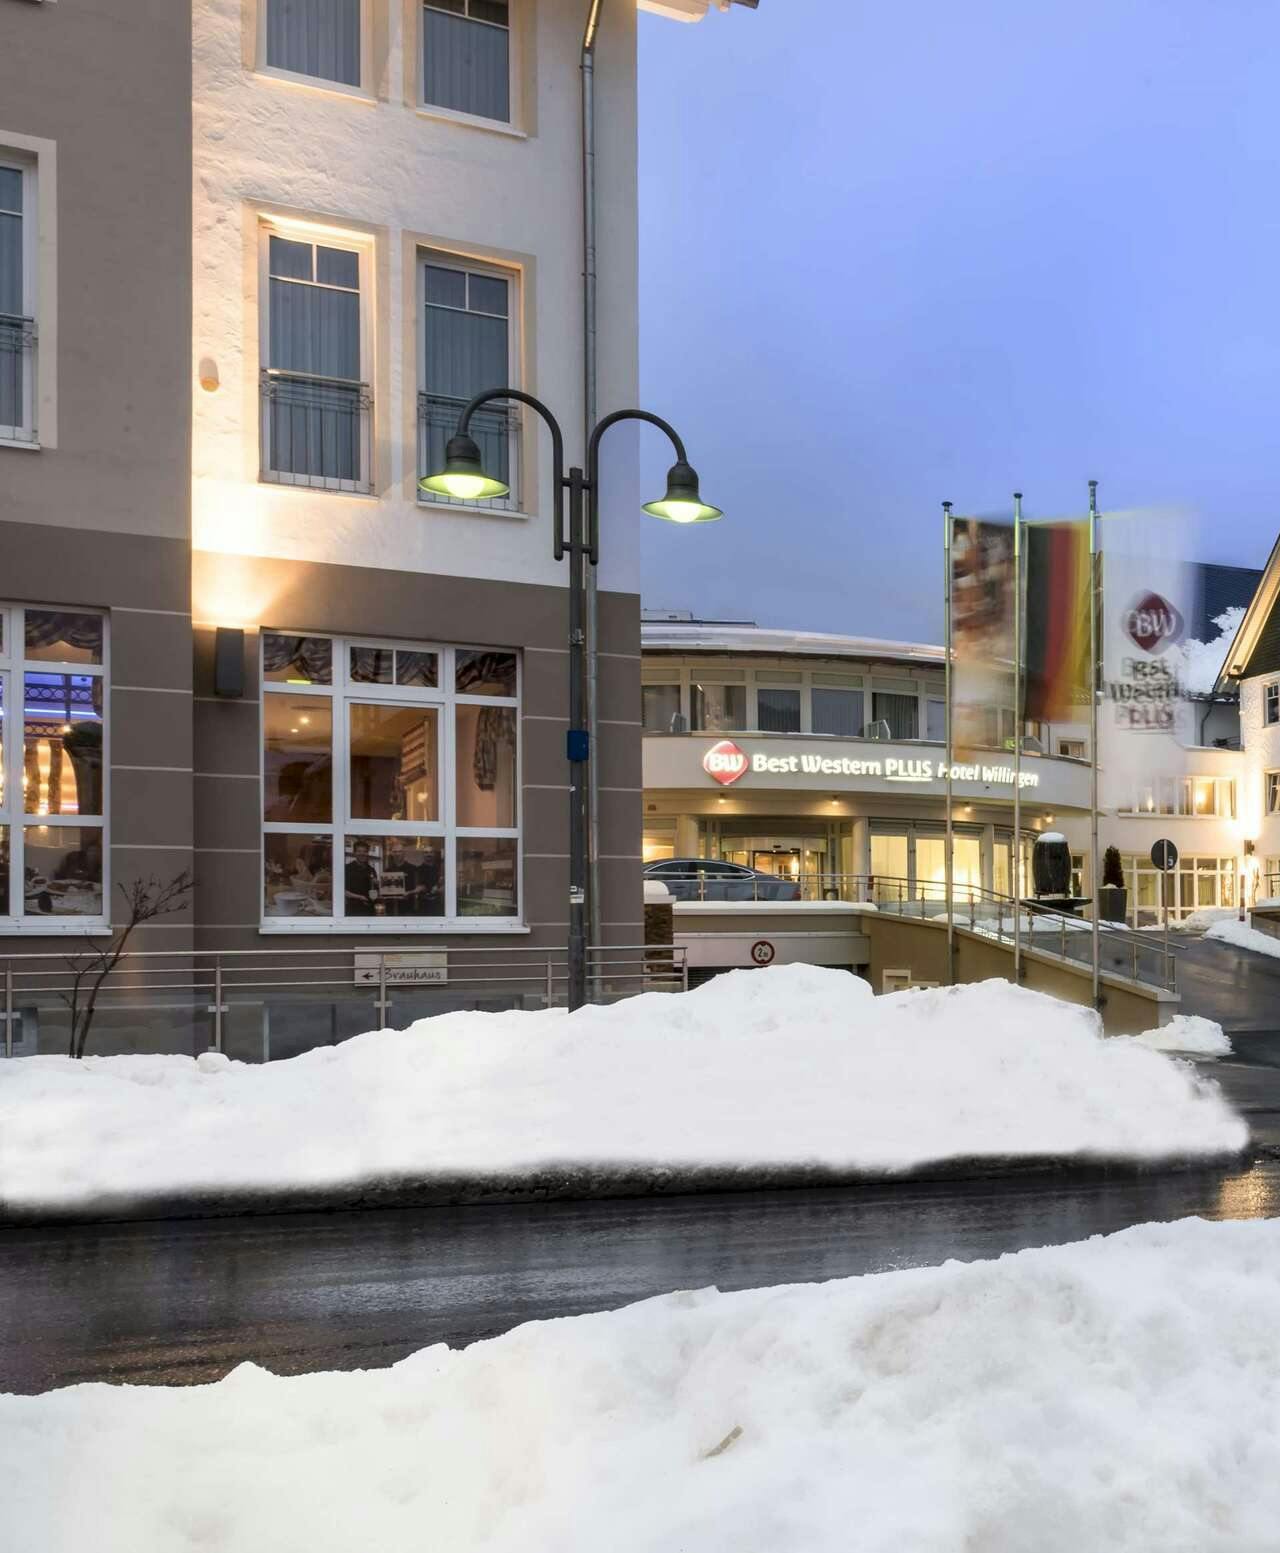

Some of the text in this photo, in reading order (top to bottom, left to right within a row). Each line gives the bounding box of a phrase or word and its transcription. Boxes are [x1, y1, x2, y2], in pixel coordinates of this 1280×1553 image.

[1136, 611, 1177, 637] BW
[709, 753, 743, 773] BW
[753, 753, 799, 773] Best
[801, 754, 882, 776] Western
[885, 759, 932, 778] PLUS
